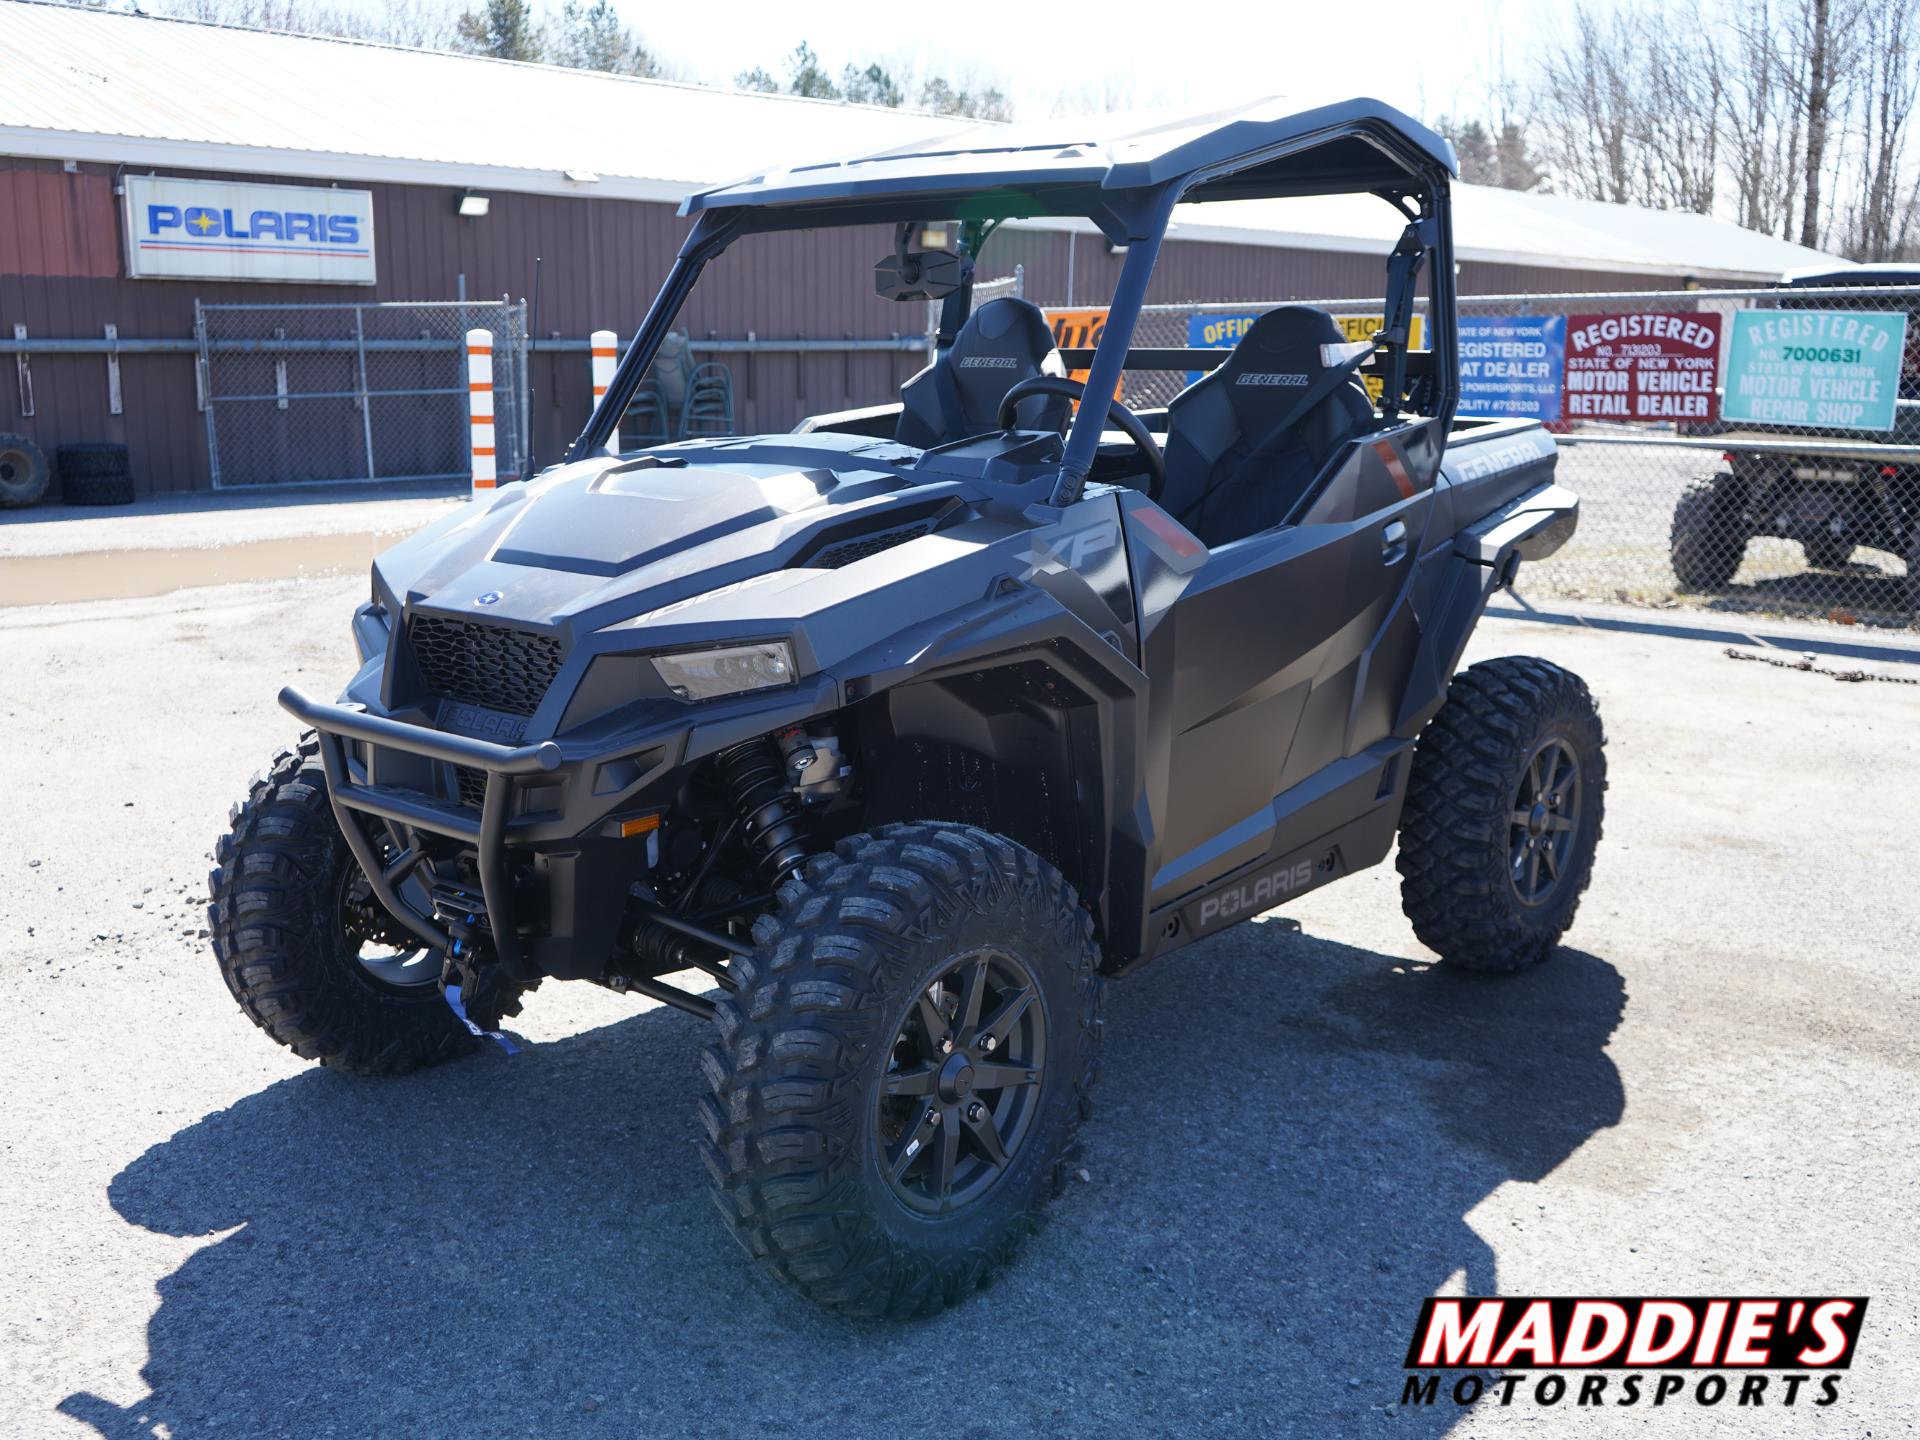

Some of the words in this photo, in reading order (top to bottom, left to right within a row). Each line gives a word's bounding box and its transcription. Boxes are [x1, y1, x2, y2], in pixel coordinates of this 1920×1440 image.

[147, 204, 360, 244] POLARIS
[1478, 327, 1492, 336] OF
[1493, 327, 1516, 336] NEW
[1516, 327, 1542, 336] YORK
[1571, 315, 1716, 352] REGISTERED
[1748, 315, 1890, 351] REGISTERED
[1596, 345, 1614, 357] NO.
[1620, 344, 1662, 356] 7131203
[1759, 348, 1781, 361] NO.
[1782, 346, 1861, 363] 7000631
[959, 357, 1018, 369] GENERAL
[1460, 362, 1481, 377] AT
[1484, 362, 1550, 378] DEALER
[1568, 358, 1611, 370] STATE
[1614, 358, 1634, 370] OF
[1637, 358, 1669, 370] NEW
[1673, 358, 1715, 370] YORK
[1748, 362, 1788, 375] STATE
[1791, 364, 1807, 376] OF
[1810, 365, 1838, 377] NEW
[1841, 366, 1876, 379] YORK
[1235, 373, 1309, 386] GENERAL
[1466, 382, 1537, 394] POWERSPORTS,
[1538, 383, 1557, 394] LLC
[1567, 371, 1630, 392] MOTOR
[1636, 371, 1713, 393] VEHICLE
[1739, 375, 1802, 398] MOTOR
[1810, 378, 1882, 403] VEHICLE
[1569, 394, 1632, 416] RETAIL
[1636, 395, 1709, 417] DEALER
[1750, 397, 1810, 421] REPAIR
[1816, 401, 1864, 425] SHOP
[1013, 520, 1118, 582] XP
[441, 703, 532, 740] POLARIS
[1200, 860, 1312, 926] POLARIS
